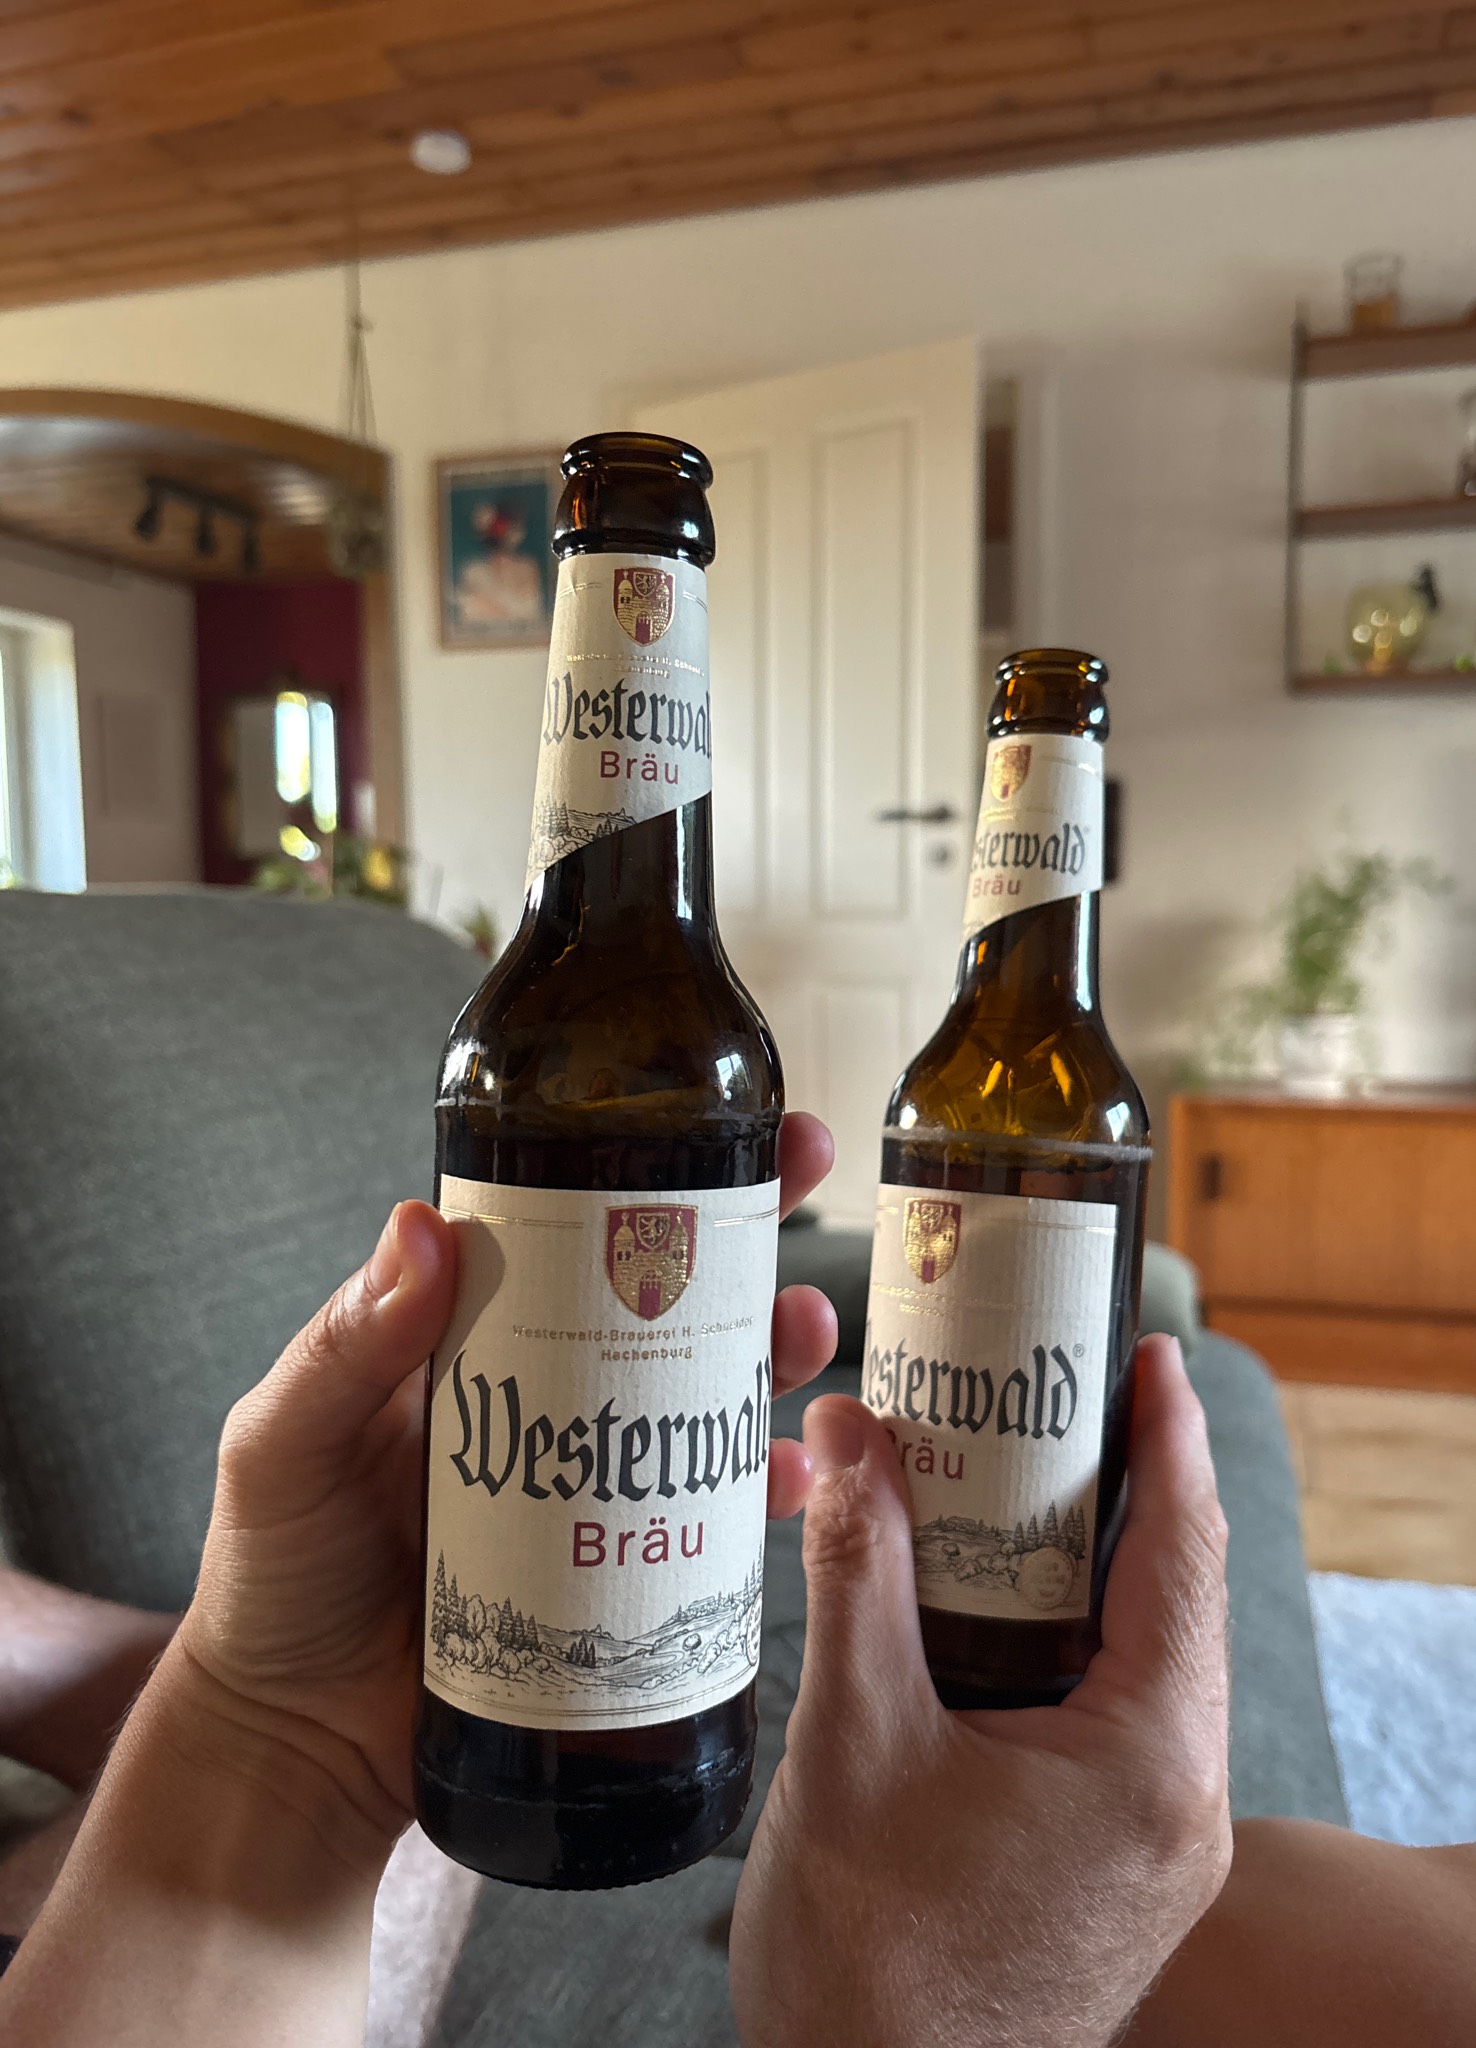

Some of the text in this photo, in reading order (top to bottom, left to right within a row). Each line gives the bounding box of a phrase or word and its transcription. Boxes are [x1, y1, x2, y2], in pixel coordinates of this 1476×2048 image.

[543, 672, 711, 759] Westerwal
[600, 750, 679, 785] Bräu
[972, 874, 1021, 898] Bräu
[513, 1315, 754, 1343] Westerwald-Brauerei H. Schneider
[601, 1345, 693, 1362] Hachenburg
[886, 1427, 965, 1480] räu
[573, 1516, 704, 1568] Bräu
